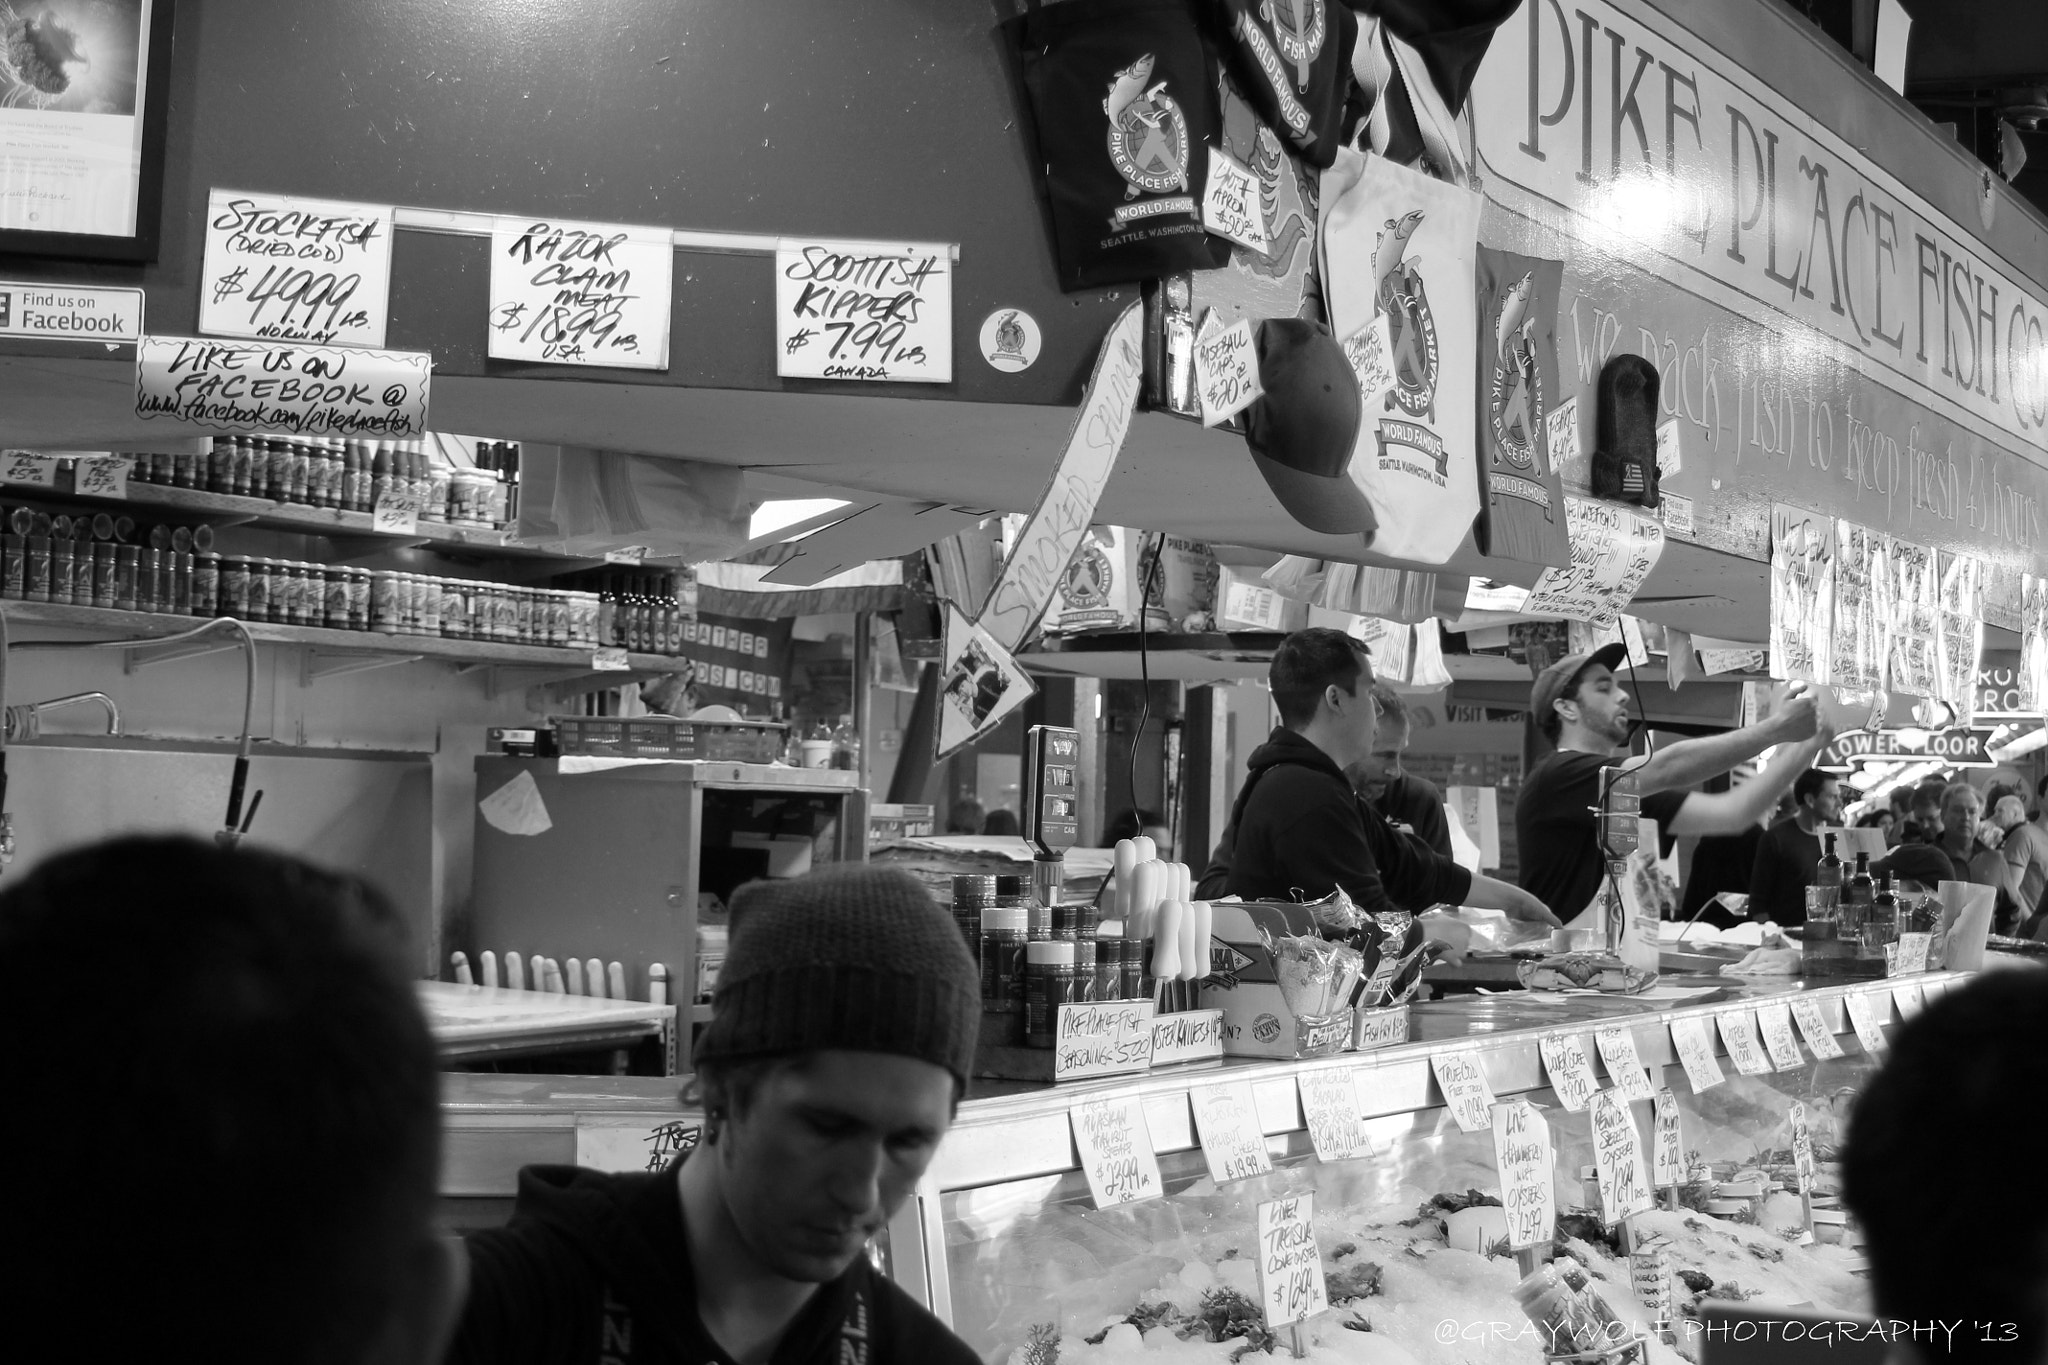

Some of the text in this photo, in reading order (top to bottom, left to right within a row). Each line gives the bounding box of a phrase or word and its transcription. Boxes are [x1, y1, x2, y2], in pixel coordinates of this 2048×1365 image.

[1284, 36, 1306, 60] FISH
[1245, 10, 1276, 74] WORLD
[1273, 67, 1307, 129] FAMOUS
[1111, 113, 1187, 189] PIKE PLACE FISH MARKET
[1117, 199, 1194, 220] WORLD FAMOUS
[1212, 187, 1248, 218] APRON
[1518, 0, 1707, 250] PIKE
[1725, 104, 1904, 358] PLACE
[1914, 232, 2000, 405] FISH
[213, 199, 382, 253] STOCKFISH
[508, 222, 629, 266] RAZOR
[530, 263, 631, 294] CLAM
[785, 246, 946, 293] SCOTTISH
[23, 292, 96, 309] Find us on
[553, 289, 641, 314] MEAT
[793, 281, 926, 324] KIPPERS
[23, 310, 124, 333] Facebook
[256, 322, 338, 345] NORWAY
[168, 343, 346, 380] LIKE US ON
[1200, 330, 1248, 369] BASEBALL
[1210, 355, 1236, 378] CAPS
[1414, 307, 1438, 410] FISH MARKET
[175, 371, 407, 406] FACEBOOK @
[823, 365, 892, 380] CANADA
[1491, 367, 1504, 412] PIKE
[1533, 366, 1543, 442] MARKET
[1382, 422, 1442, 457] WORLD FAMOUS
[1493, 416, 1518, 462] PLACE
[1803, 380, 1833, 471] to
[1844, 393, 1901, 525] keep
[1907, 425, 1960, 529] fresh
[1993, 460, 2040, 549] hours
[1490, 475, 1549, 505] WORLD FAMOUS
[993, 475, 1092, 650] SMOKED
[1445, 704, 1483, 723] VISIT
[1827, 735, 1979, 764] LOWER LOOR
[1062, 1007, 1087, 1039] PIKE
[1117, 1007, 1145, 1046] FISH
[1364, 1023, 1380, 1043] FISH
[1506, 1105, 1528, 1136] LIVE
[1602, 1140, 1633, 1173] OYSTERS
[1507, 1182, 1546, 1215] OYSTERS
